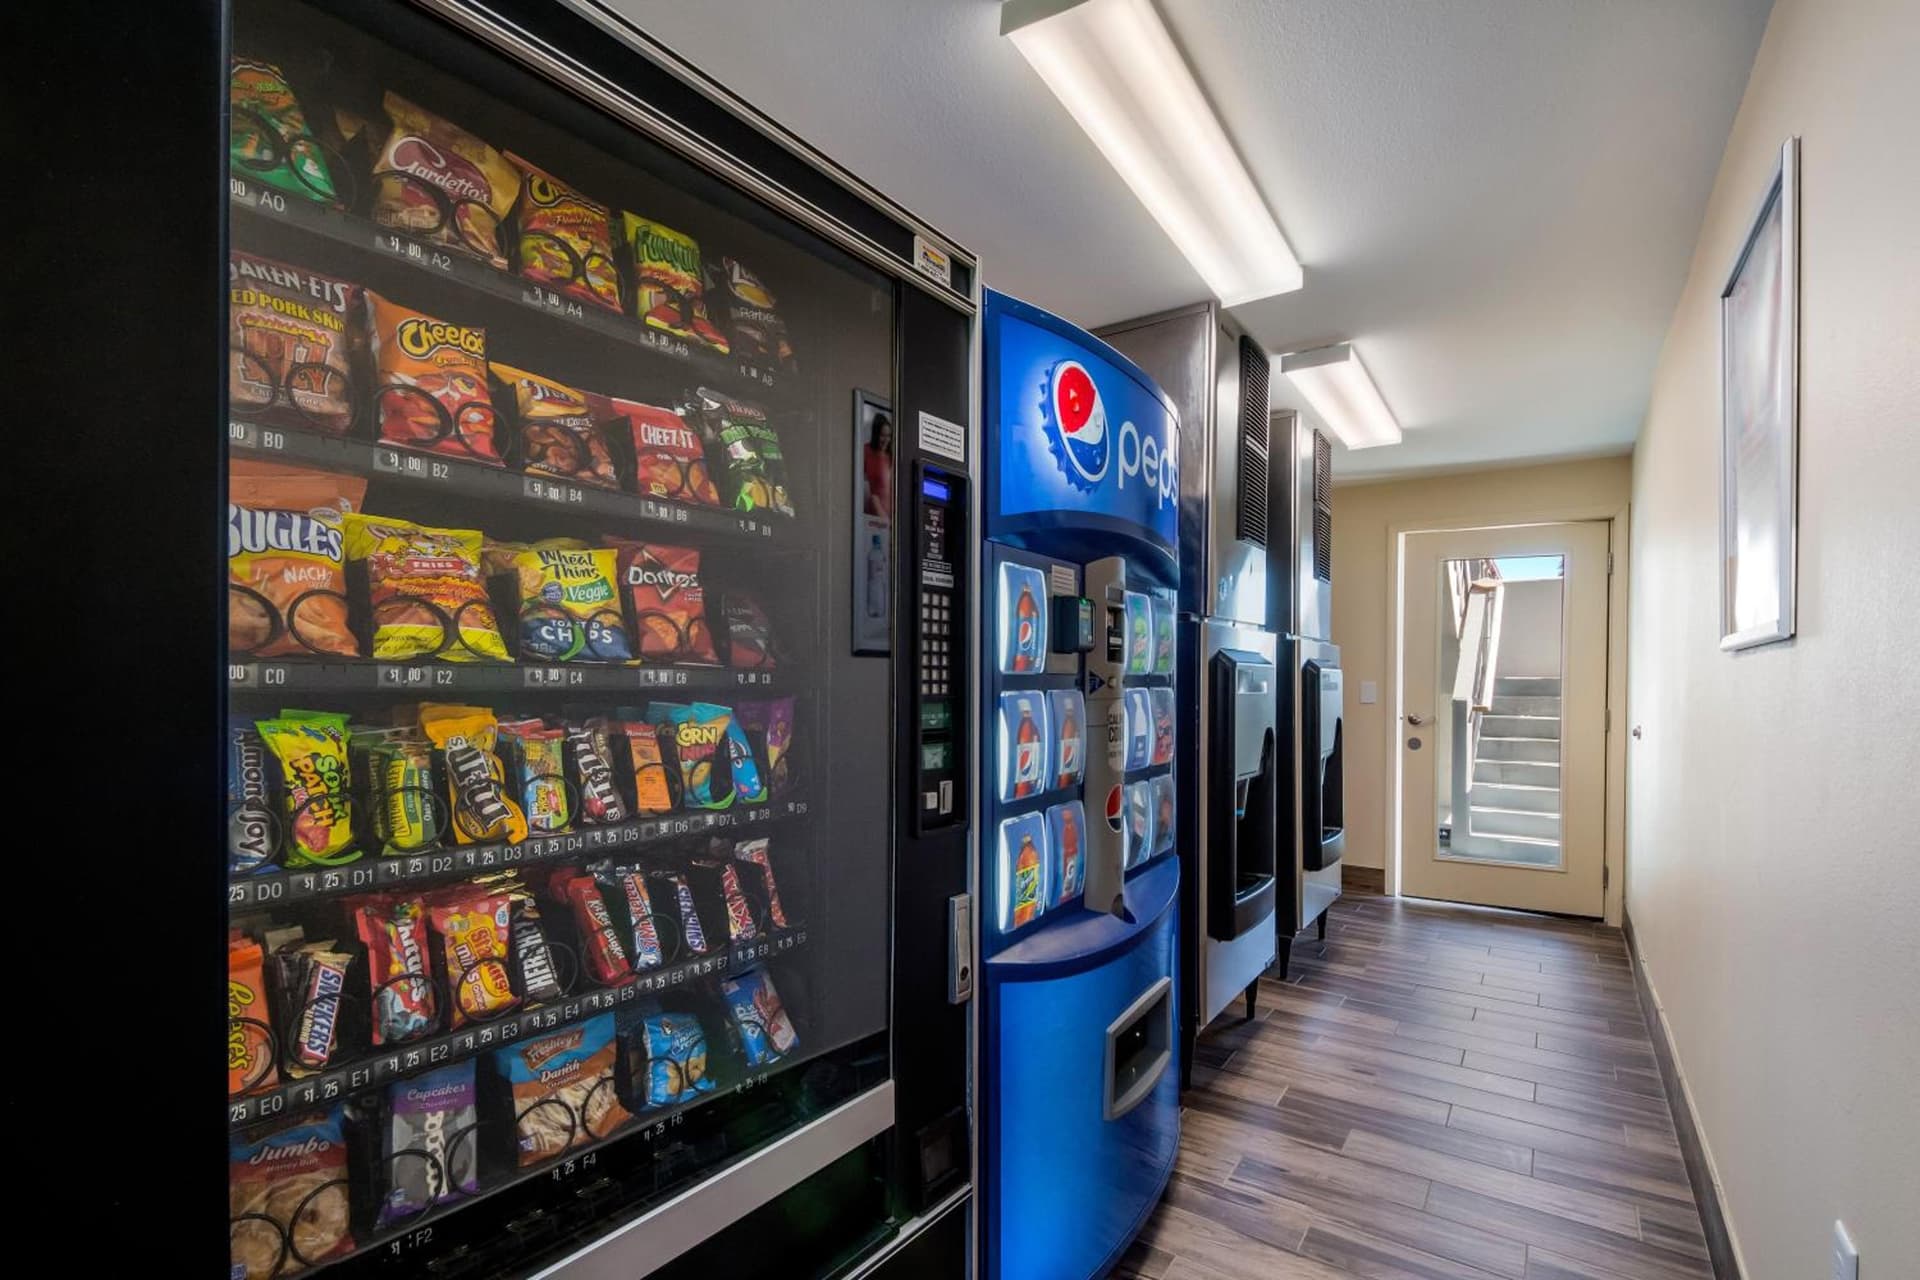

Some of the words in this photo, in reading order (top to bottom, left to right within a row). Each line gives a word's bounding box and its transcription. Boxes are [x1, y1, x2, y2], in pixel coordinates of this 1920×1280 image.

[388, 135, 490, 204] Gardetto's
[260, 191, 285, 212] A0
[432, 253, 451, 271] A2
[258, 292, 310, 321] PORK
[567, 302, 583, 318] A4
[399, 320, 485, 360] Cheetos
[432, 463, 449, 479] B2
[570, 488, 583, 503] B4
[538, 549, 596, 568] Wheat
[541, 562, 601, 580] Thins
[628, 565, 699, 588] Doritos
[568, 583, 609, 602] Veggie
[541, 625, 613, 644] CHPS
[437, 669, 453, 685] C2
[570, 671, 583, 684] C4
[676, 672, 688, 685] C6
[675, 721, 719, 748] CORN
[237, 807, 270, 858] Joy
[623, 828, 639, 842] D5
[675, 820, 688, 833] D6
[567, 836, 583, 851] D4
[504, 846, 522, 861] D3
[432, 856, 453, 873] D2
[353, 869, 373, 886] D1
[257, 882, 283, 901] D0
[621, 986, 635, 1001] E5
[306, 968, 342, 1060] SNICKERS
[564, 1003, 580, 1019] E4
[502, 1022, 519, 1039] E3
[430, 1044, 449, 1062] E2
[352, 1068, 370, 1087] E1
[540, 1059, 583, 1083] Danish
[406, 1082, 467, 1103] Cupcakes
[260, 1095, 283, 1116] E0
[250, 1135, 331, 1166] Jumbo
[582, 1152, 596, 1169] F4
[416, 1227, 433, 1248] F2
